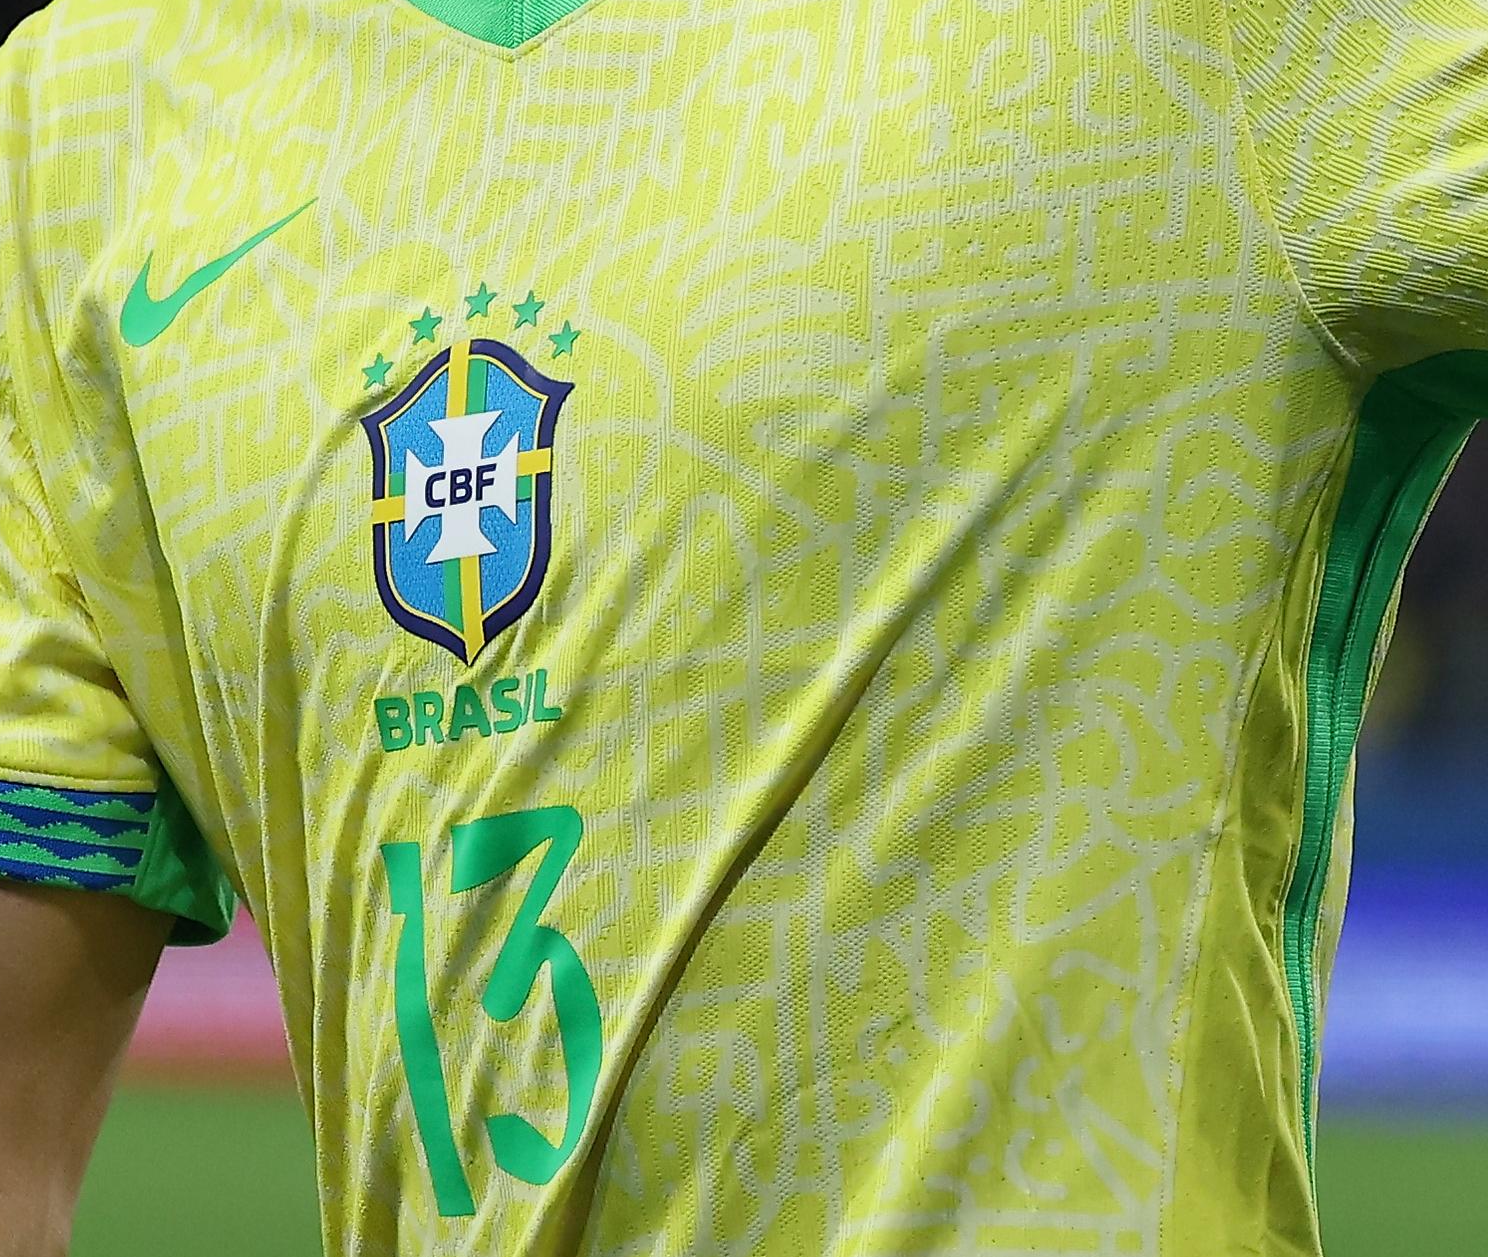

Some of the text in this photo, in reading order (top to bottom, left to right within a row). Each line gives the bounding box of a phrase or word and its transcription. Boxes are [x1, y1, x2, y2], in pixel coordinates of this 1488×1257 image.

[424, 463, 497, 509] CBF
[373, 668, 562, 752] BRASIL
[379, 805, 603, 1217] 13
